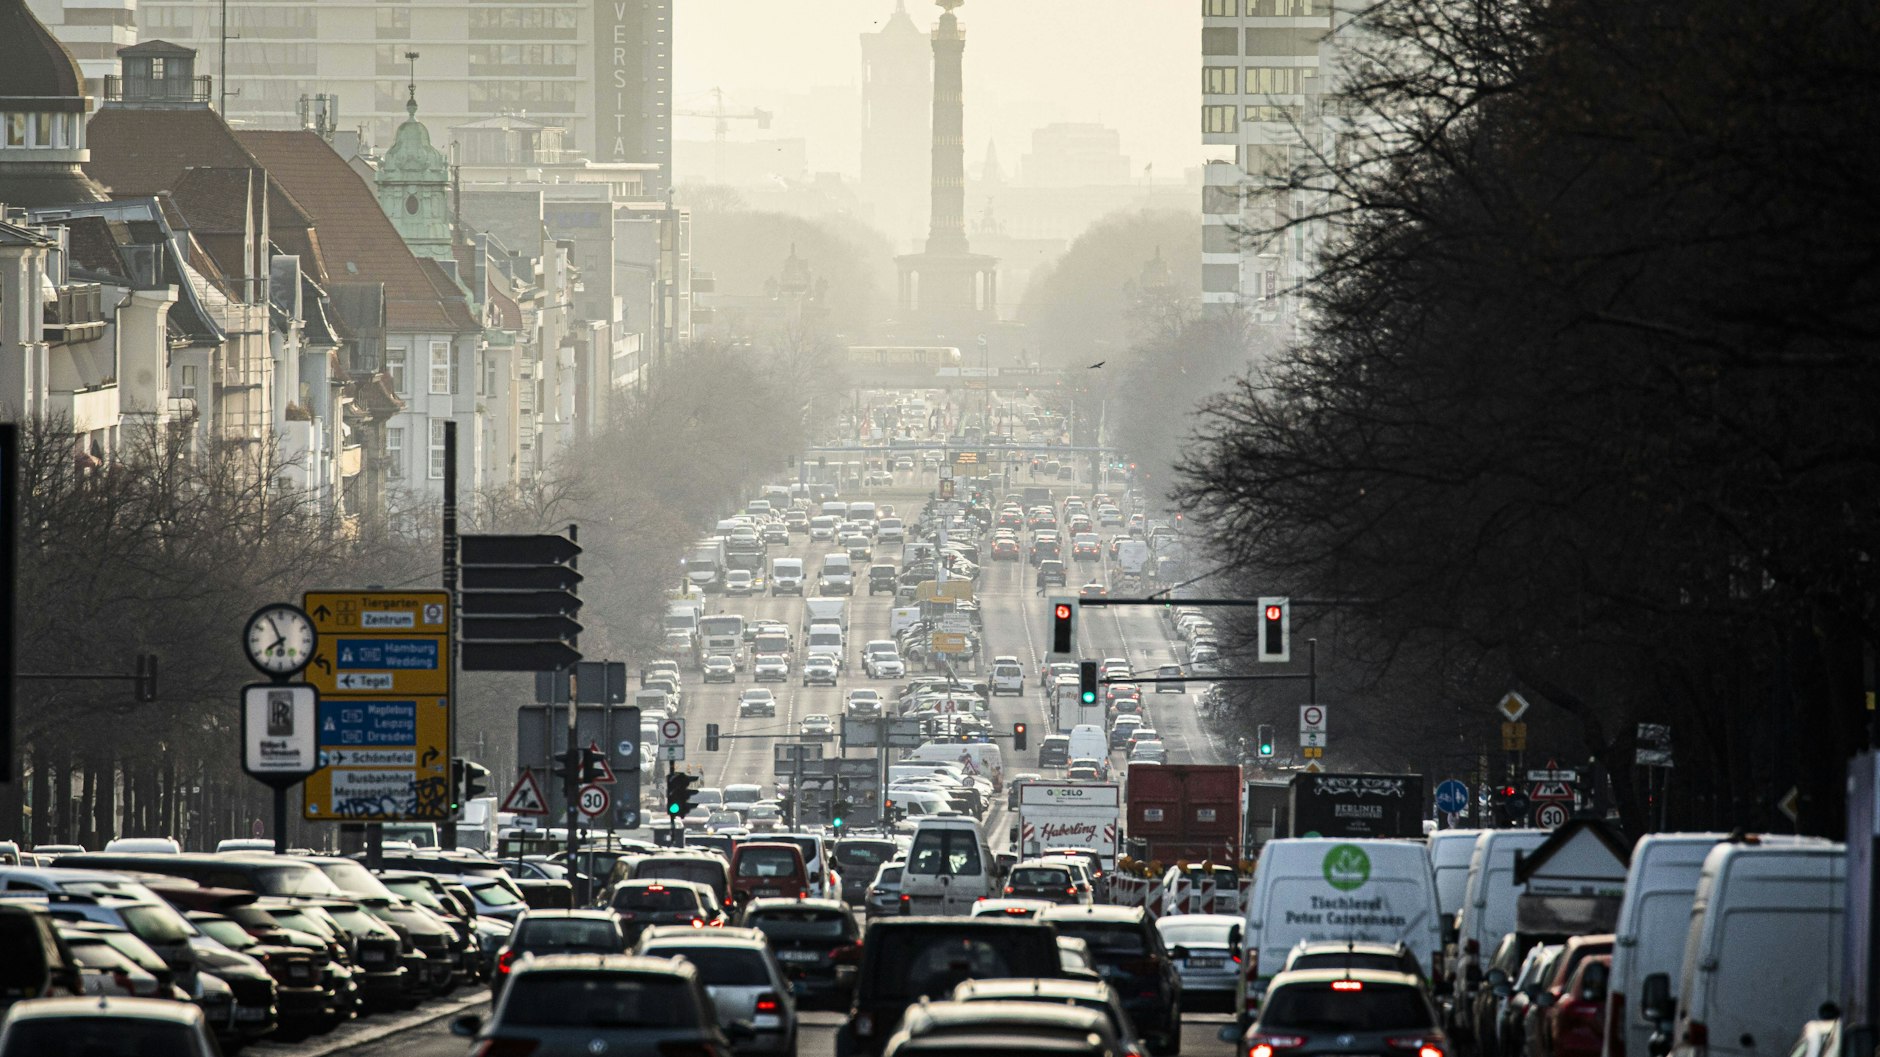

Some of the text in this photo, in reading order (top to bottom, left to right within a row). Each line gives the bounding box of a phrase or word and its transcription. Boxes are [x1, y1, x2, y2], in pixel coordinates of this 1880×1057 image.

[613, 2, 626, 162] VERSITÄ
[363, 598, 419, 610] Tiergarten
[364, 614, 412, 625] Zentrum
[385, 643, 435, 654] Hamburg
[386, 657, 433, 668] Wedding
[361, 676, 389, 688] Tegel
[368, 705, 413, 716] Magdeburg
[375, 719, 413, 729] Leipzig
[367, 731, 413, 742] Dresden
[352, 752, 413, 762] Schönefeld
[347, 774, 413, 784] Busbahnhof
[583, 794, 602, 808] 30
[1335, 804, 1382, 812] BERLINER
[1543, 810, 1563, 825] 30
[1040, 823, 1098, 842] Haberling
[1310, 896, 1382, 910] Tischlerei
[1286, 911, 1322, 924] Peter
